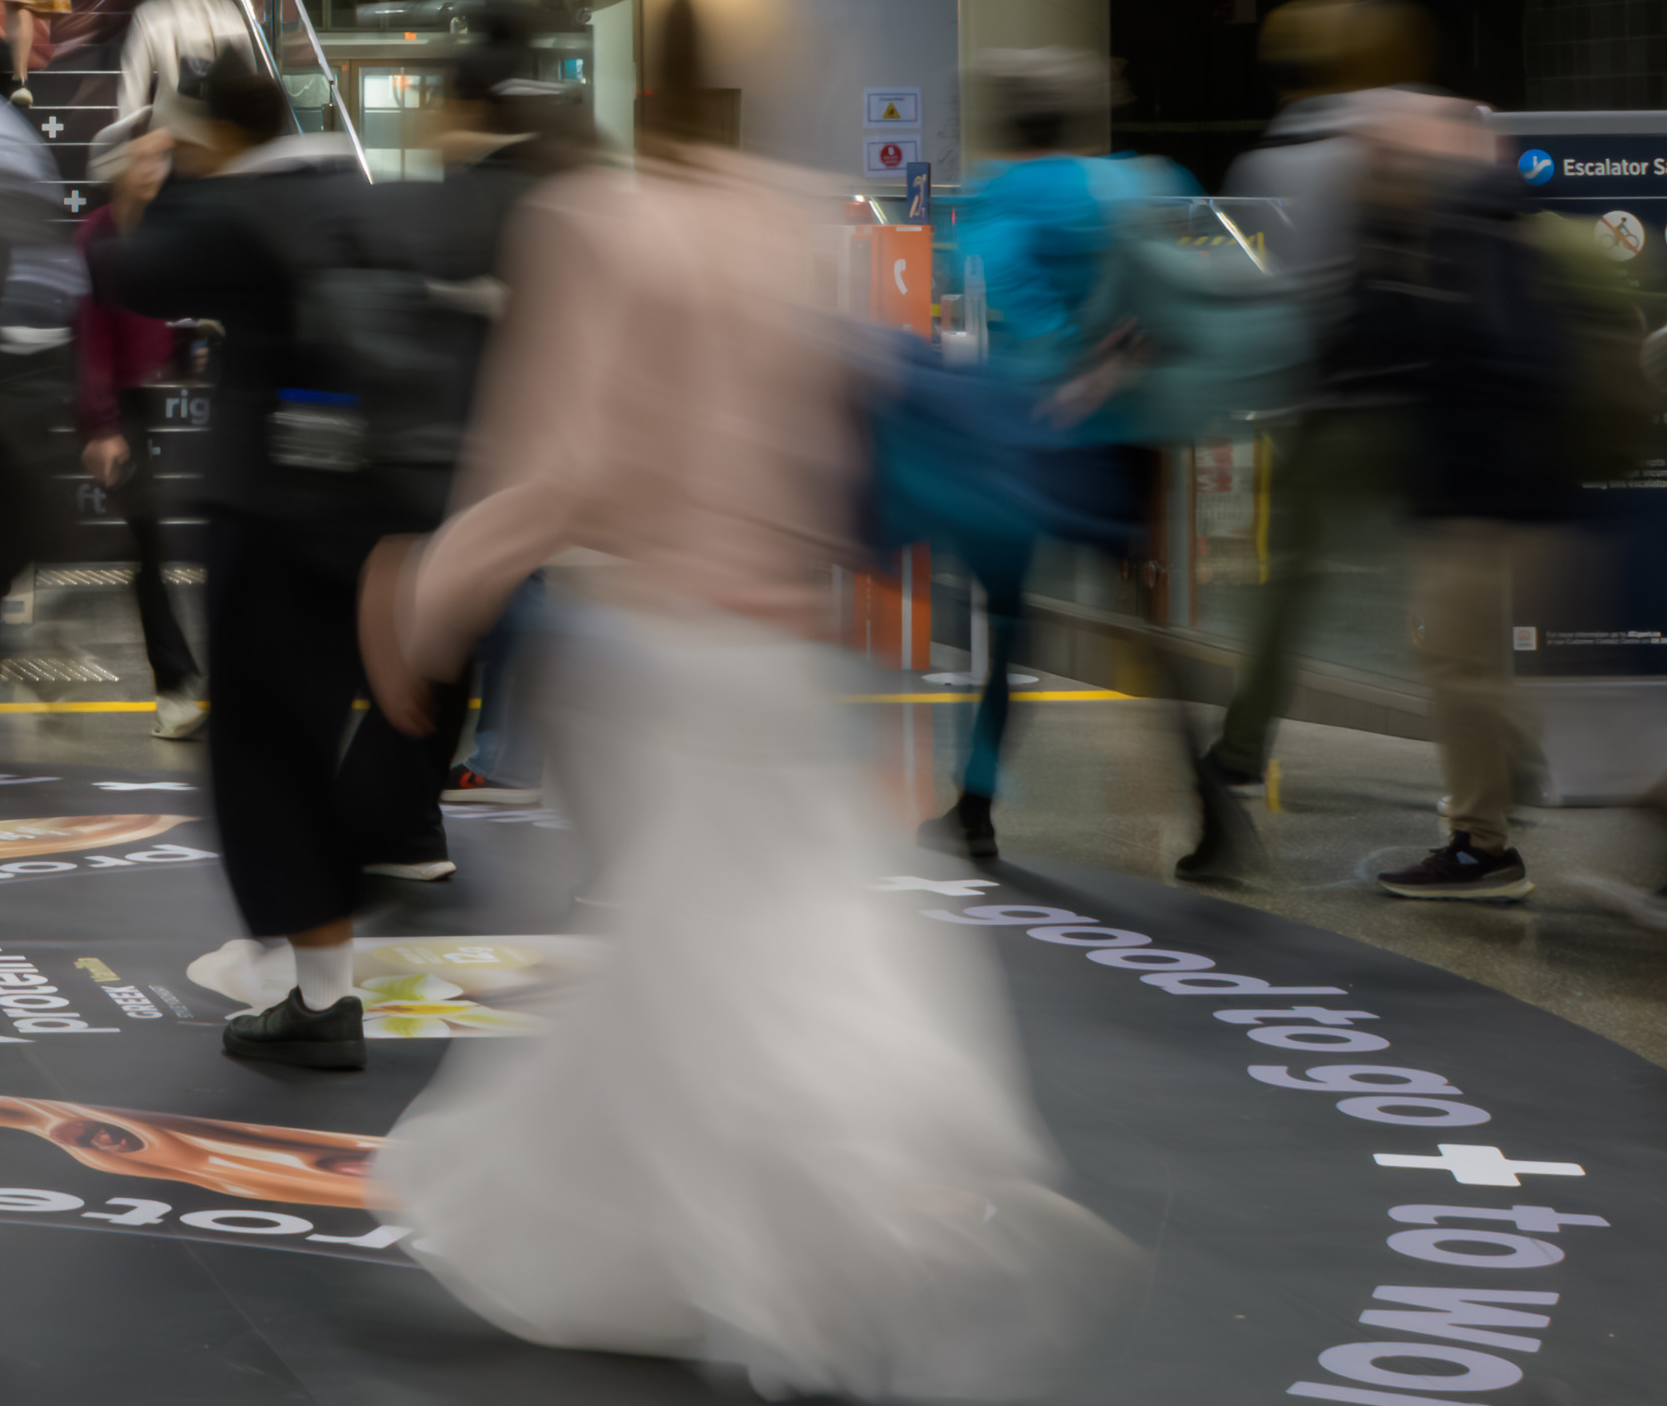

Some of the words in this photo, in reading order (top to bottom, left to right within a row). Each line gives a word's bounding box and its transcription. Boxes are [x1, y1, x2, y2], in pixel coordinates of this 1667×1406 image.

[1563, 158, 1649, 177] Escalator
[917, 904, 1351, 995] good
[100, 985, 164, 1020] GREEK
[1212, 1005, 1392, 1053] to
[1247, 1063, 1493, 1128] go
[1387, 1203, 1612, 1270] to
